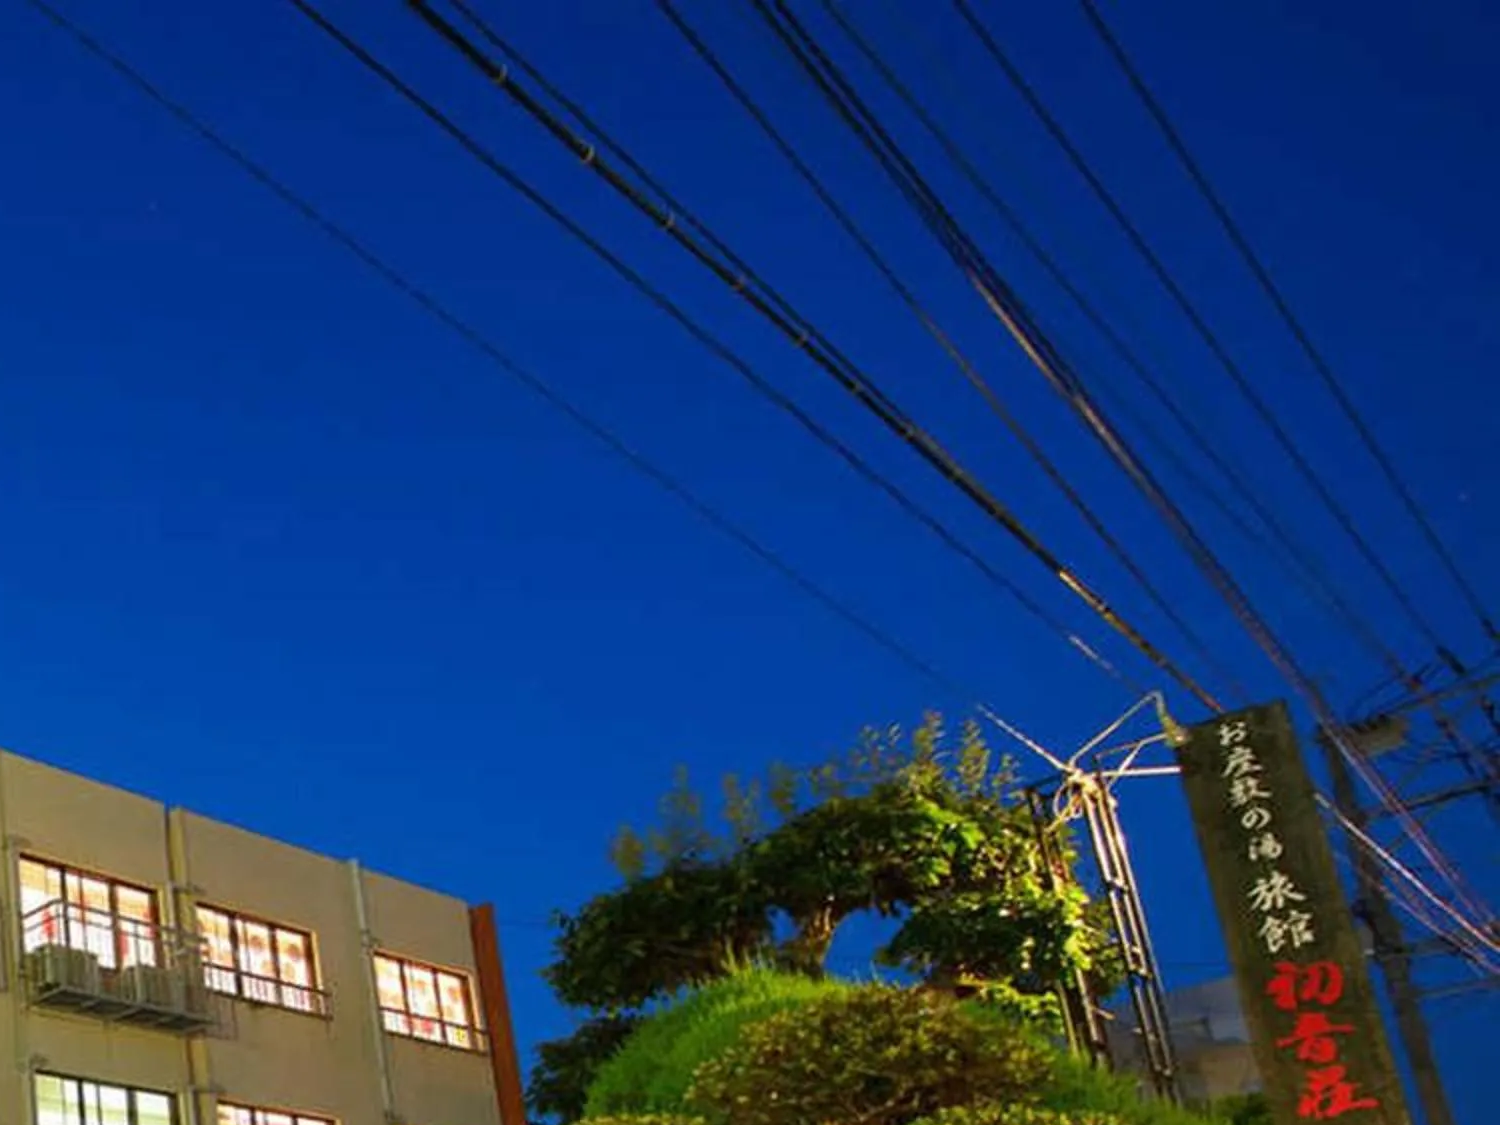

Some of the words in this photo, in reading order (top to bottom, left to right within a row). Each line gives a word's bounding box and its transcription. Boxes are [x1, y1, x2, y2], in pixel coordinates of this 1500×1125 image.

[1247, 869, 1316, 954] 旅館
[1264, 961, 1379, 1119] 初音荘
